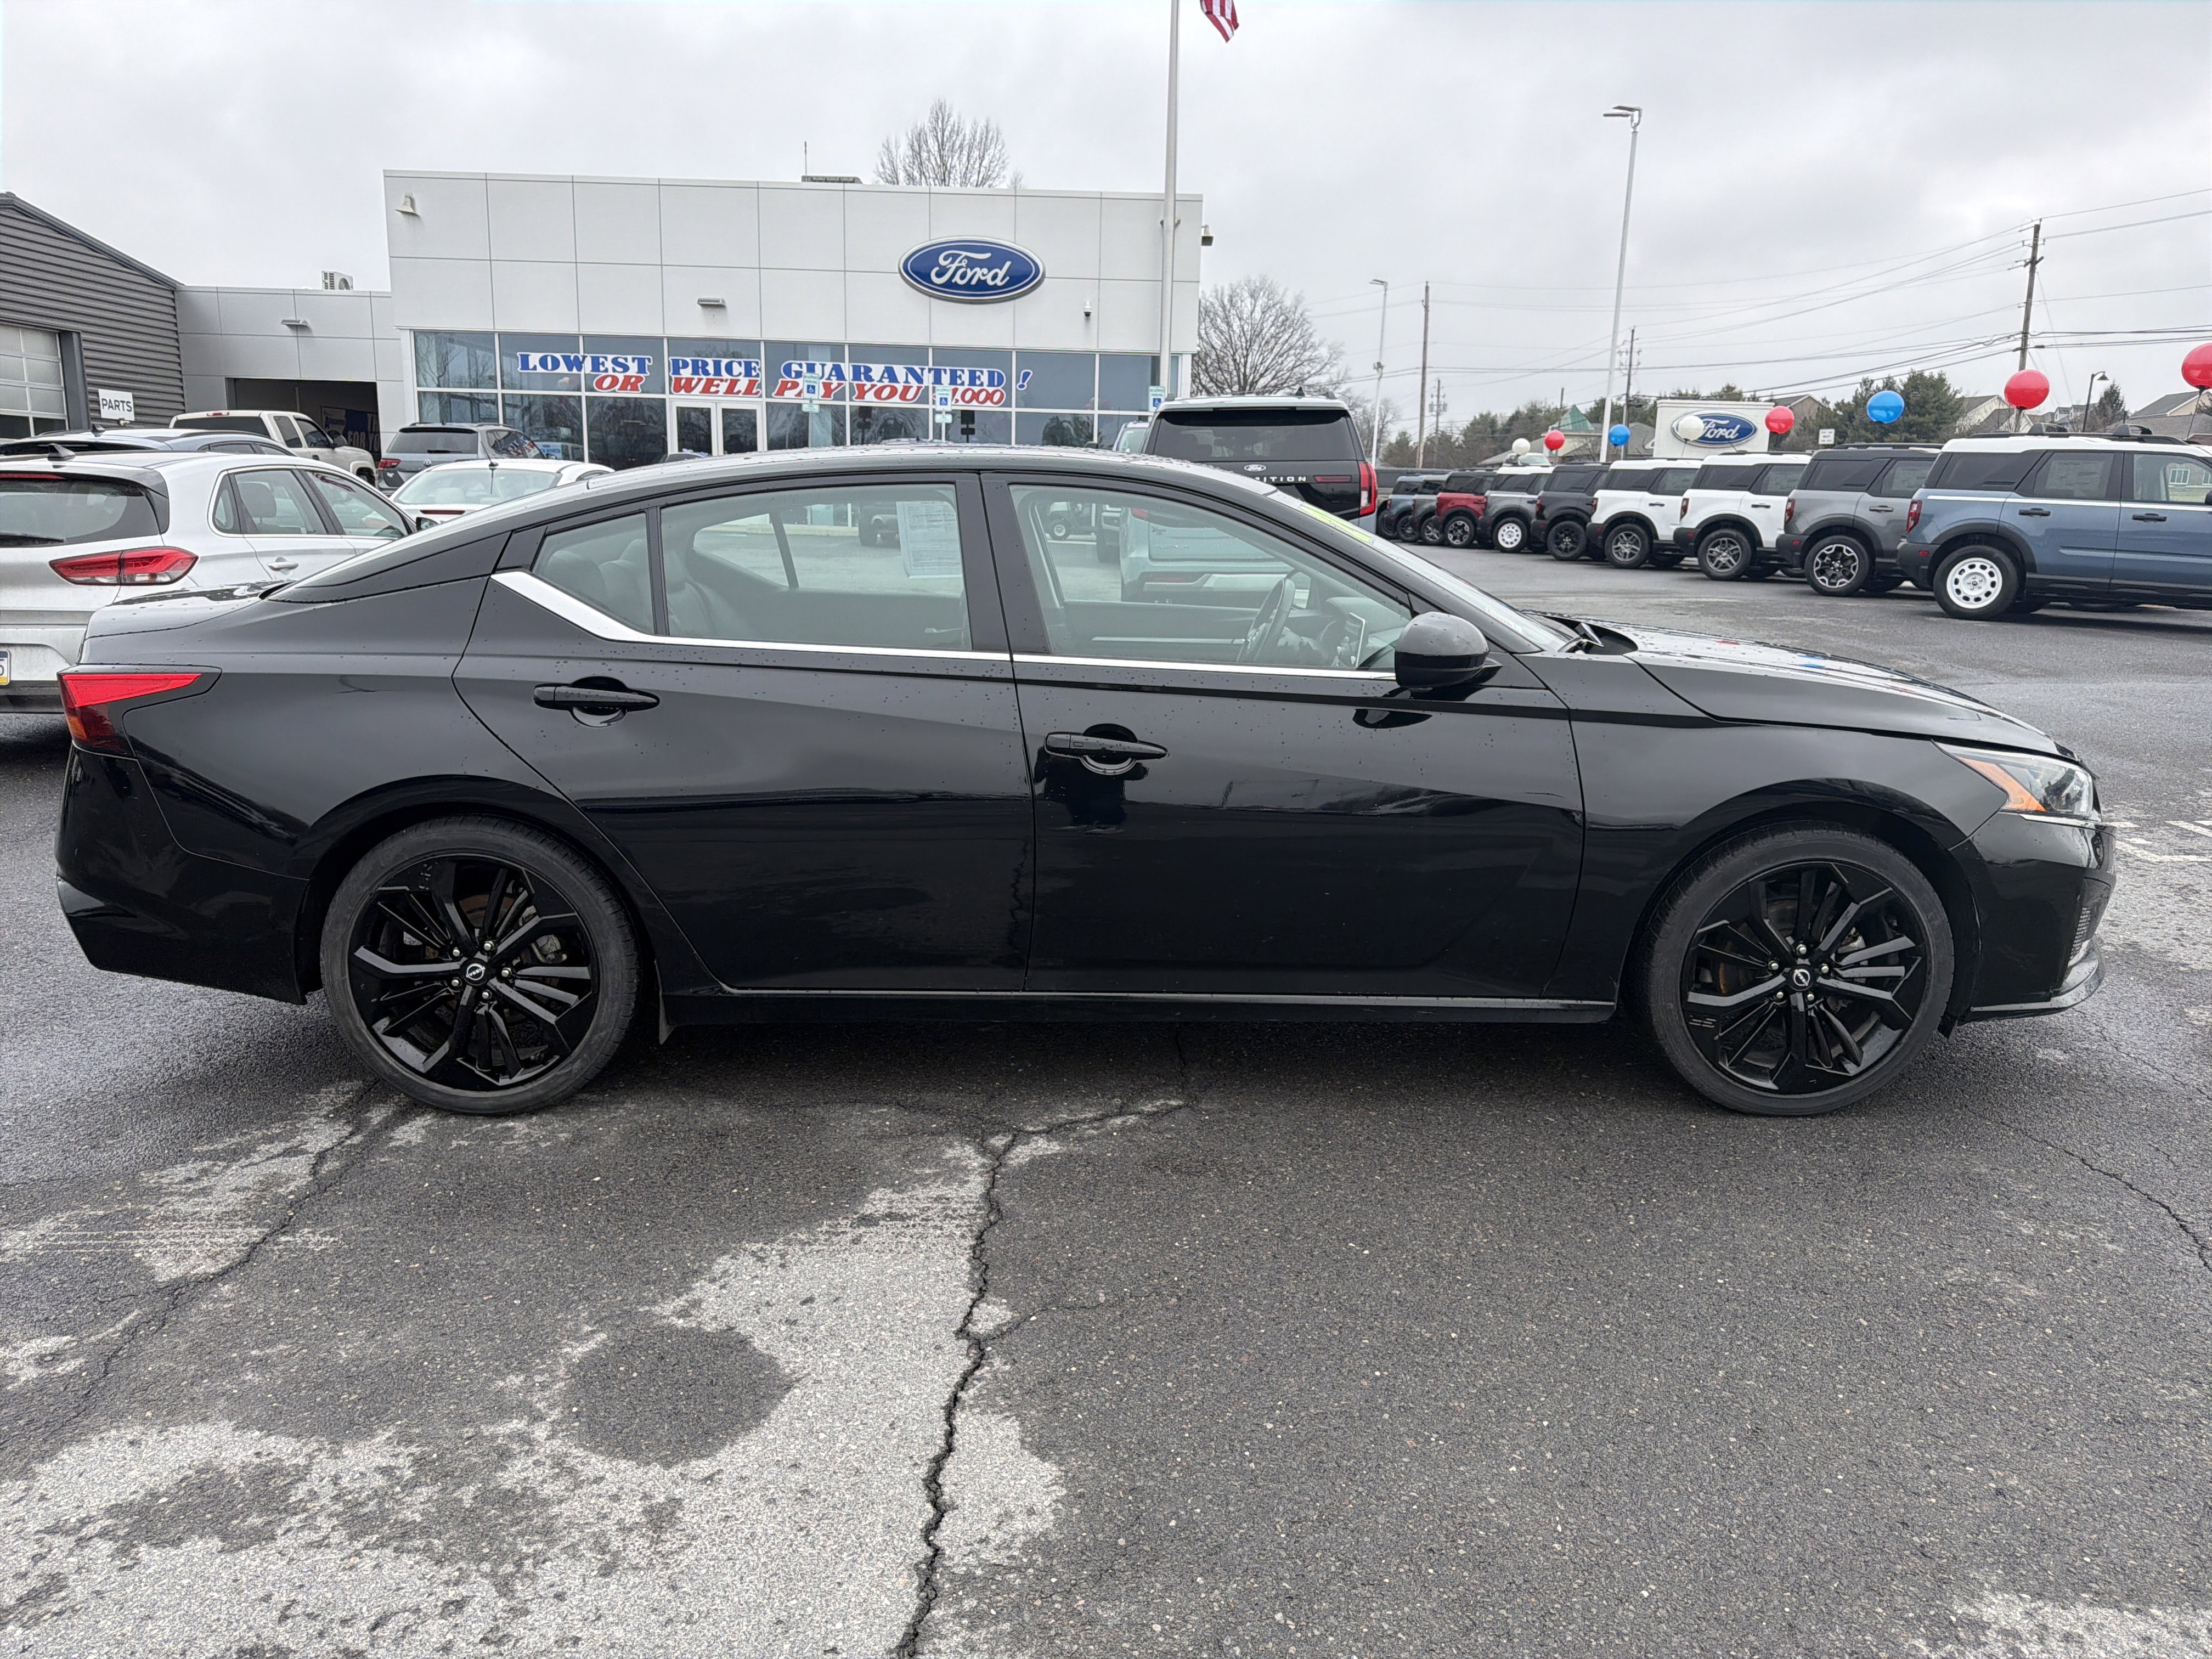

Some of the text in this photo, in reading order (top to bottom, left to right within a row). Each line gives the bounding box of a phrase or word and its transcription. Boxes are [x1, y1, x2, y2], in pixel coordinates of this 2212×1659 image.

[930, 250, 1012, 286] Ford
[518, 353, 651, 375] LOWEST
[670, 358, 760, 378] PRICE
[782, 362, 1005, 387] GUARANTEED
[595, 374, 644, 391] OR
[673, 377, 761, 396] WE'LL
[774, 380, 845, 399] PY
[854, 383, 923, 402] YOU
[101, 398, 132, 413] PARTS
[368, 432, 380, 452] YO
